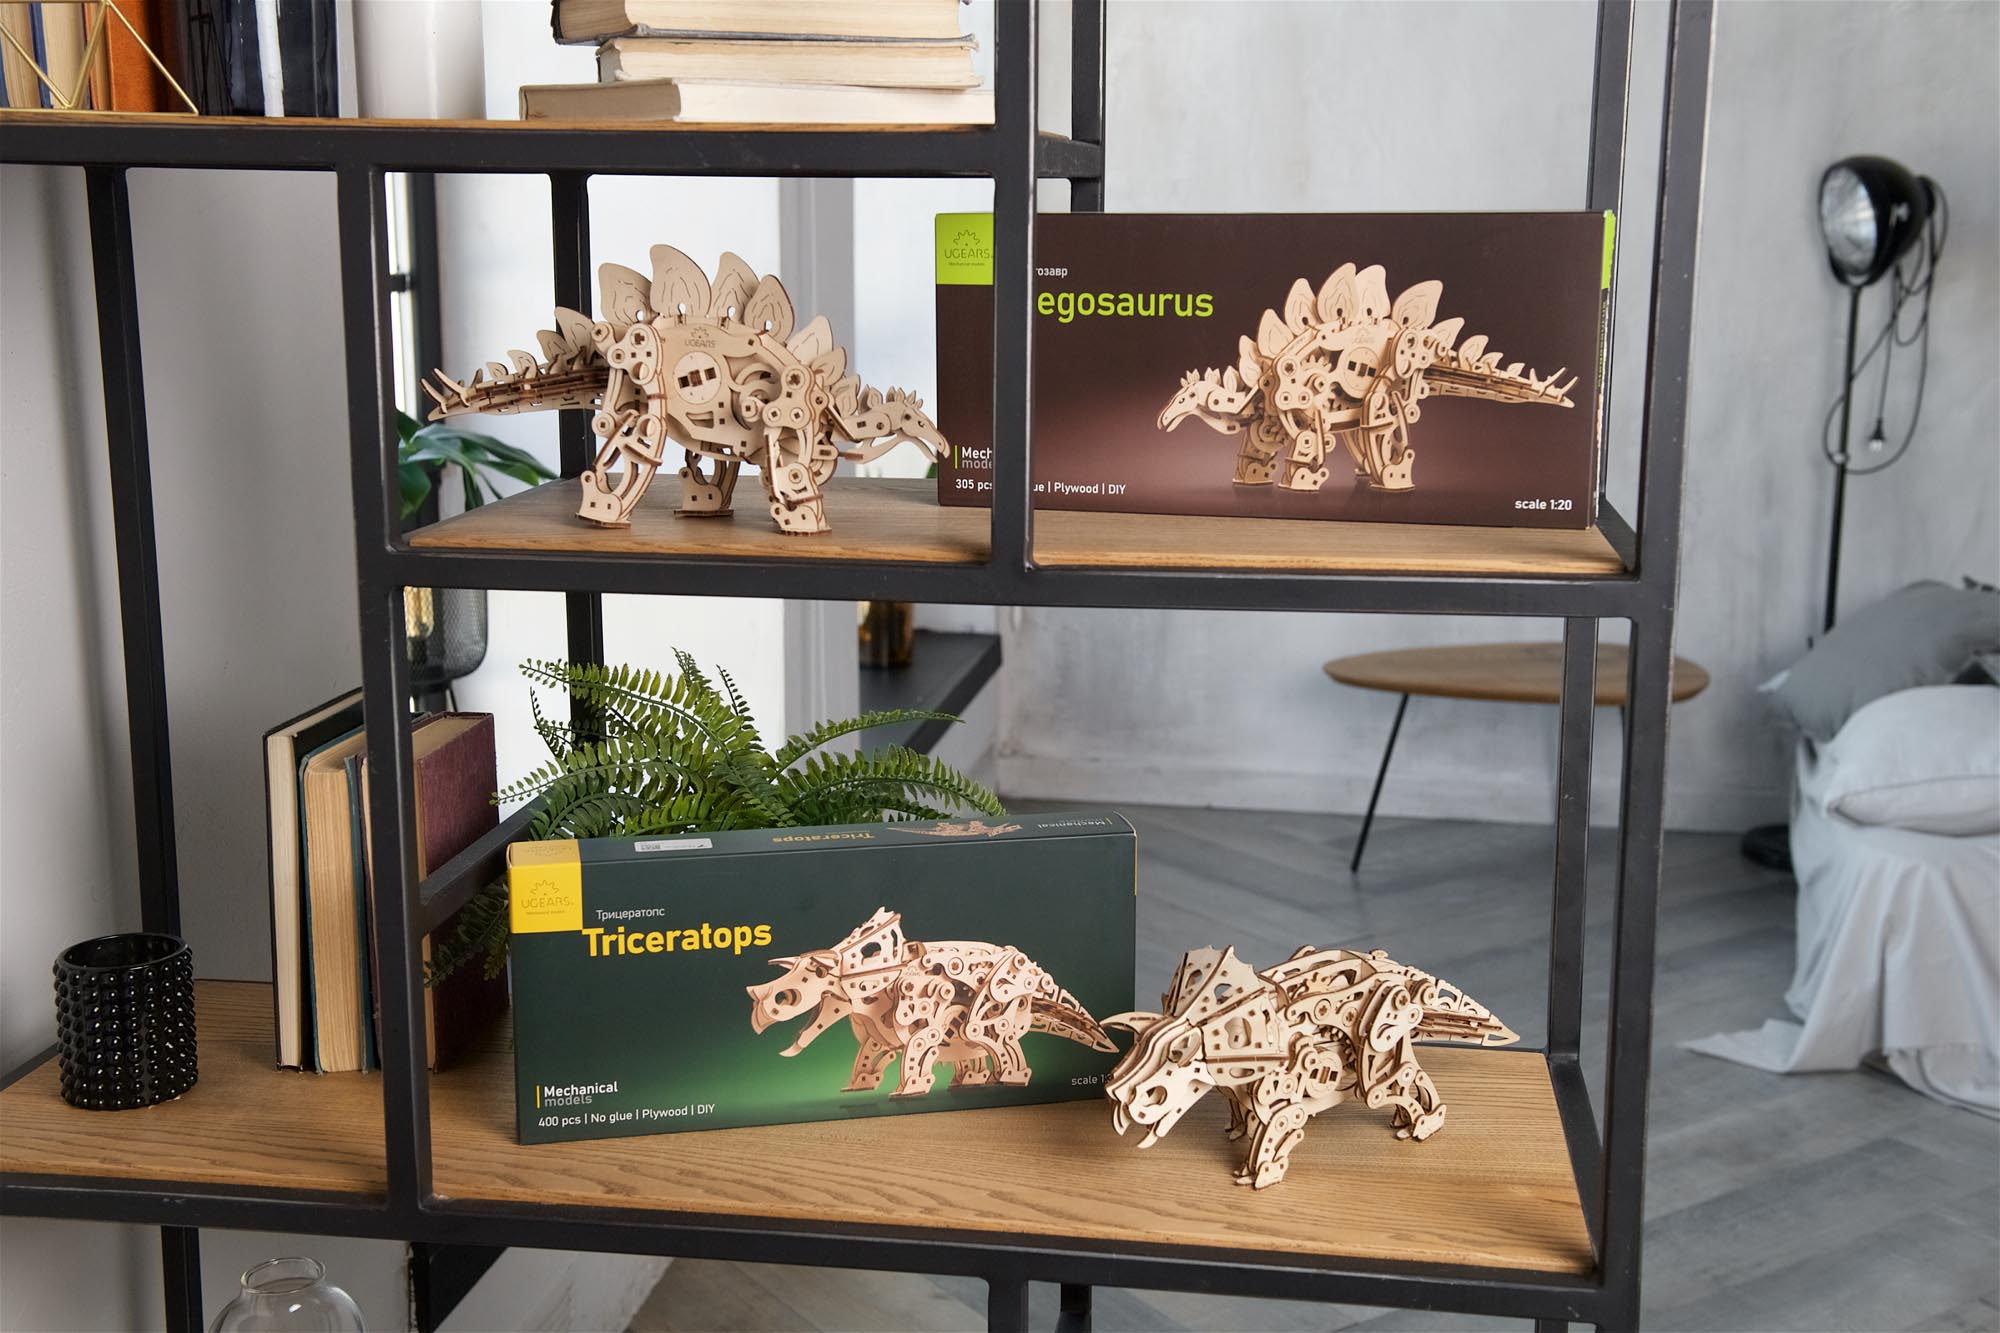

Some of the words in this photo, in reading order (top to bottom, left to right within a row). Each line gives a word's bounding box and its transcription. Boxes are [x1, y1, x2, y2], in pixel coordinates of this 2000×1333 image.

[944, 248, 990, 259] UGEARS
[1035, 267, 1068, 279] озавр
[1037, 292, 1214, 324] egosaurus
[955, 478, 975, 489] 305
[1054, 482, 1099, 495] Plywood
[1108, 484, 1126, 495] DIY
[1514, 499, 1547, 510] scale
[1549, 499, 1573, 511] 1:20
[520, 897, 570, 909] UGEARS
[595, 907, 665, 921] Трицератопс
[582, 922, 772, 957] Triceratops
[1071, 1075, 1098, 1086] scale
[544, 1081, 619, 1097] Mechanical
[544, 1094, 593, 1108] models
[538, 1116, 559, 1128] 400
[562, 1114, 582, 1128] pcs
[591, 1112, 606, 1124] No
[609, 1109, 633, 1125] glue
[642, 1105, 688, 1121] Plywood
[697, 1103, 716, 1115] DIY
